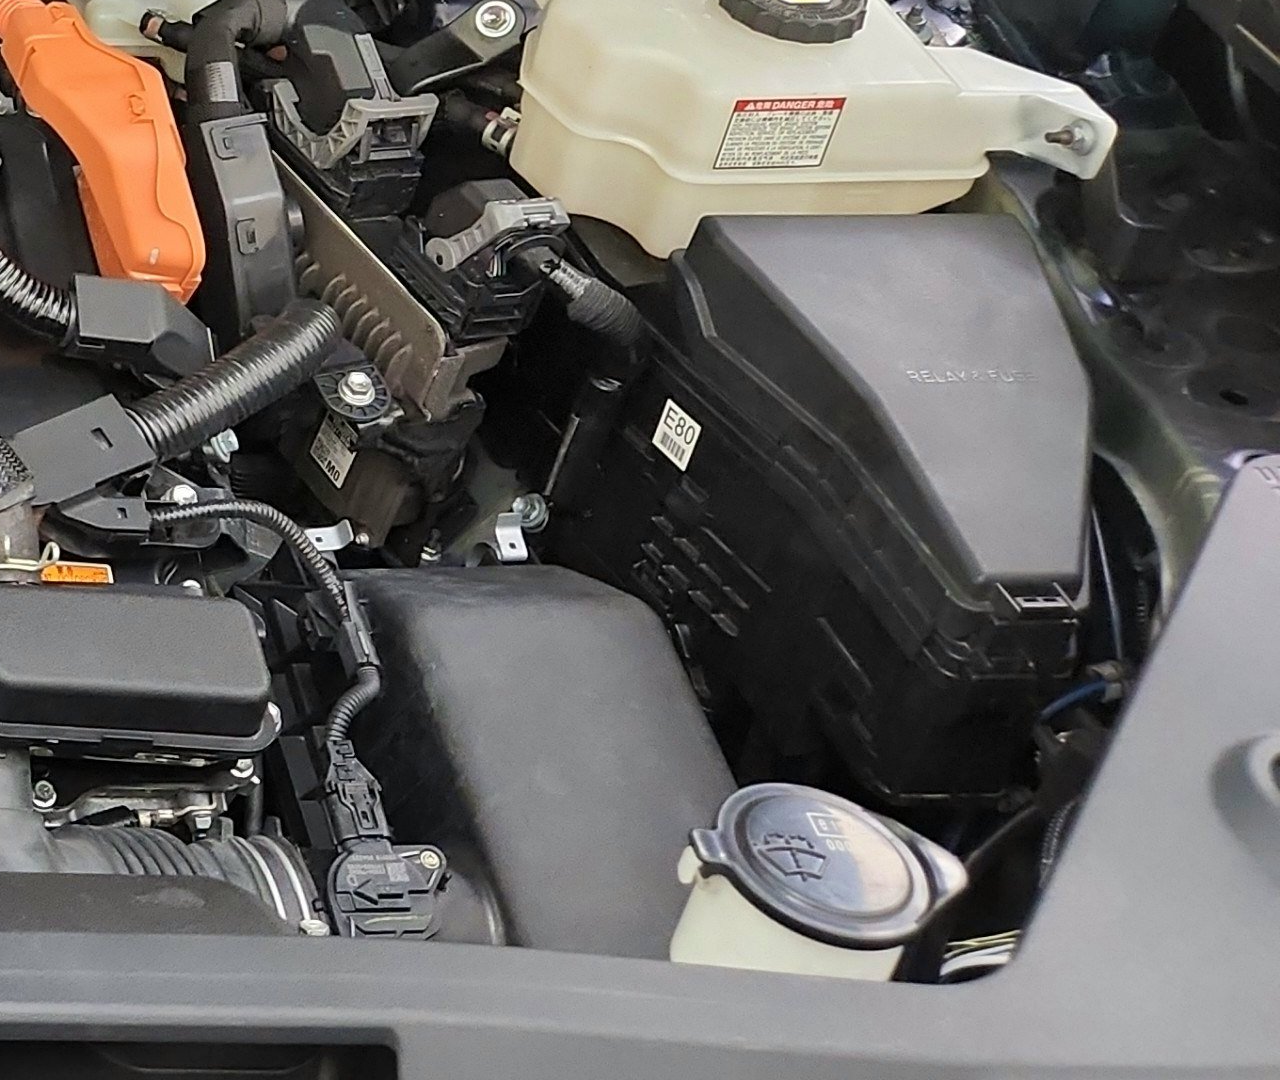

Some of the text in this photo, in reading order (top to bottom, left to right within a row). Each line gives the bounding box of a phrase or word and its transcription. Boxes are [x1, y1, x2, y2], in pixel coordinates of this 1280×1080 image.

[772, 100, 816, 110] DANGER
[905, 370, 966, 382] RELAY
[986, 369, 1040, 382] FUSE
[663, 405, 696, 446] E80
